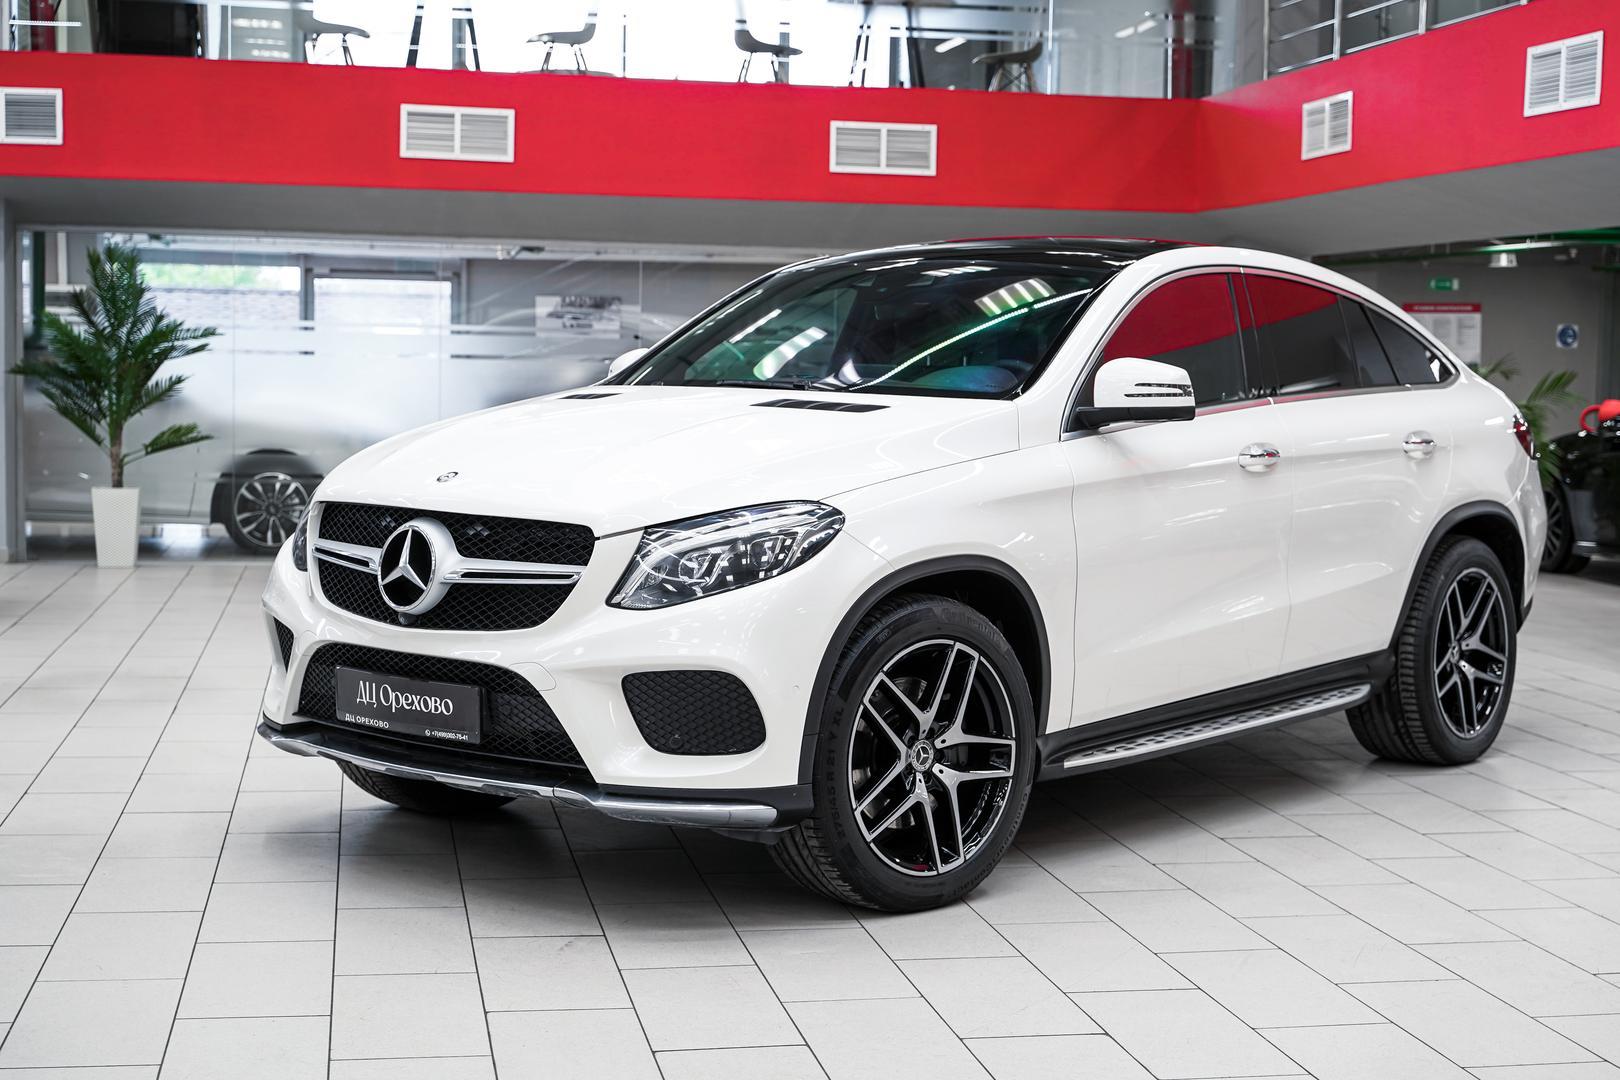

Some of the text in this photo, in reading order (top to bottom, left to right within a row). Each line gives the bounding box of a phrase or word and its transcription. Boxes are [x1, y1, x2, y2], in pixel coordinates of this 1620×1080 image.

[356, 680, 454, 716] ДЦ Орехово
[345, 713, 390, 729] ДЦ ОРЕХОВО
